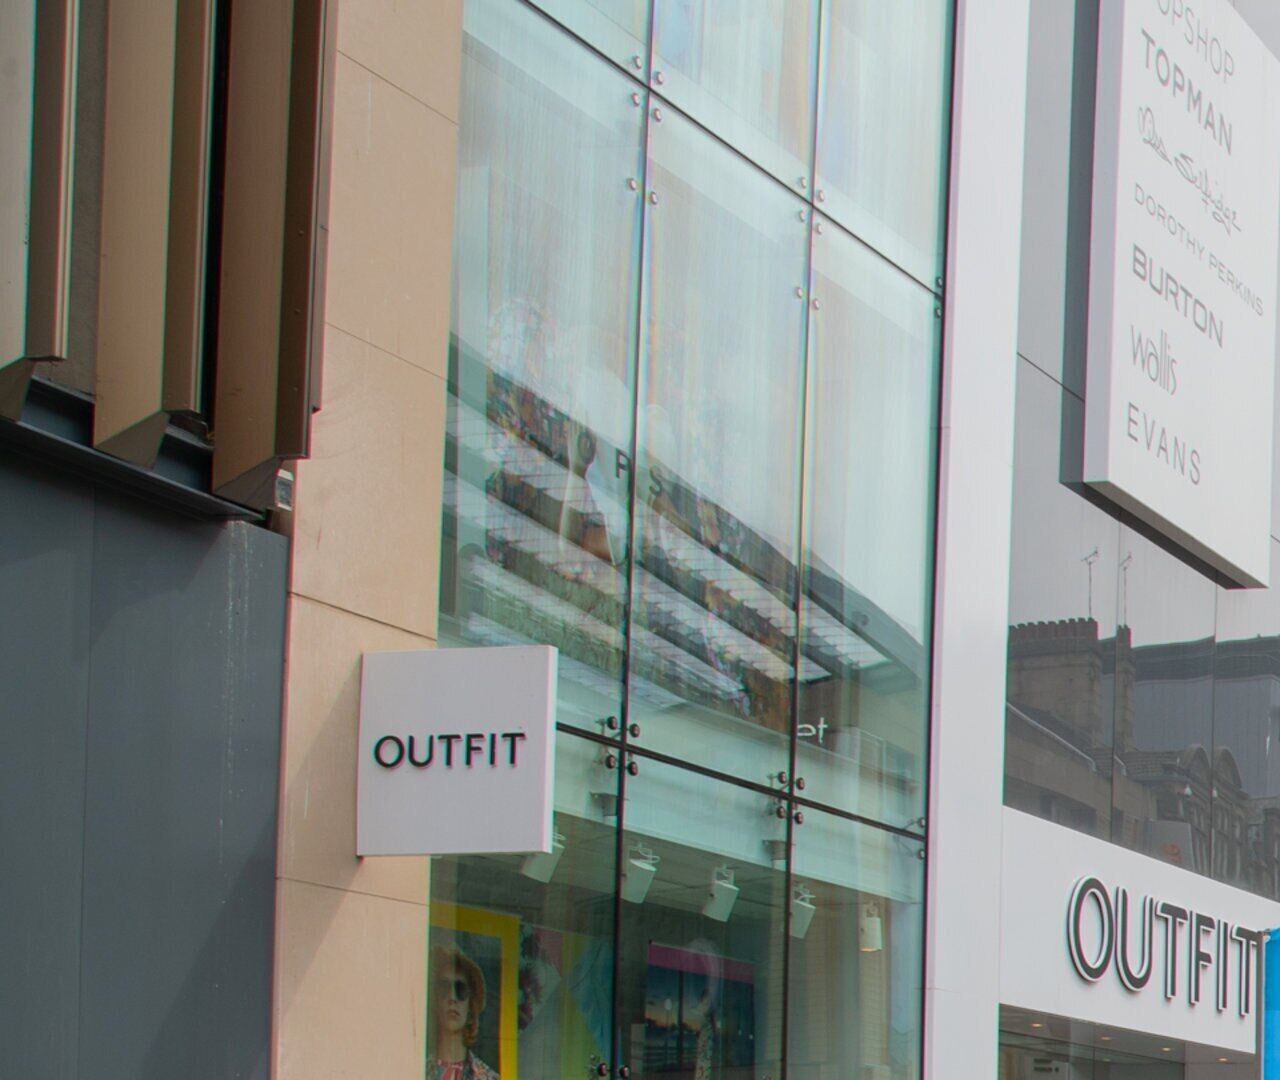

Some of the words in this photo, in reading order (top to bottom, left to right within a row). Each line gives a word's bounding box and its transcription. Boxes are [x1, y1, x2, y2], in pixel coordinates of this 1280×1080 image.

[1141, 28, 1232, 156] TOPMAN
[1158, 0, 1234, 83] PSHOP
[1132, 243, 1224, 349] BURTON
[1134, 182, 1205, 261] DOROTHY
[1208, 253, 1264, 317] PERKINS
[1126, 401, 1201, 486] EVANS
[373, 732, 527, 768] OUTFIT
[1067, 874, 1257, 1017] OUTFIT
